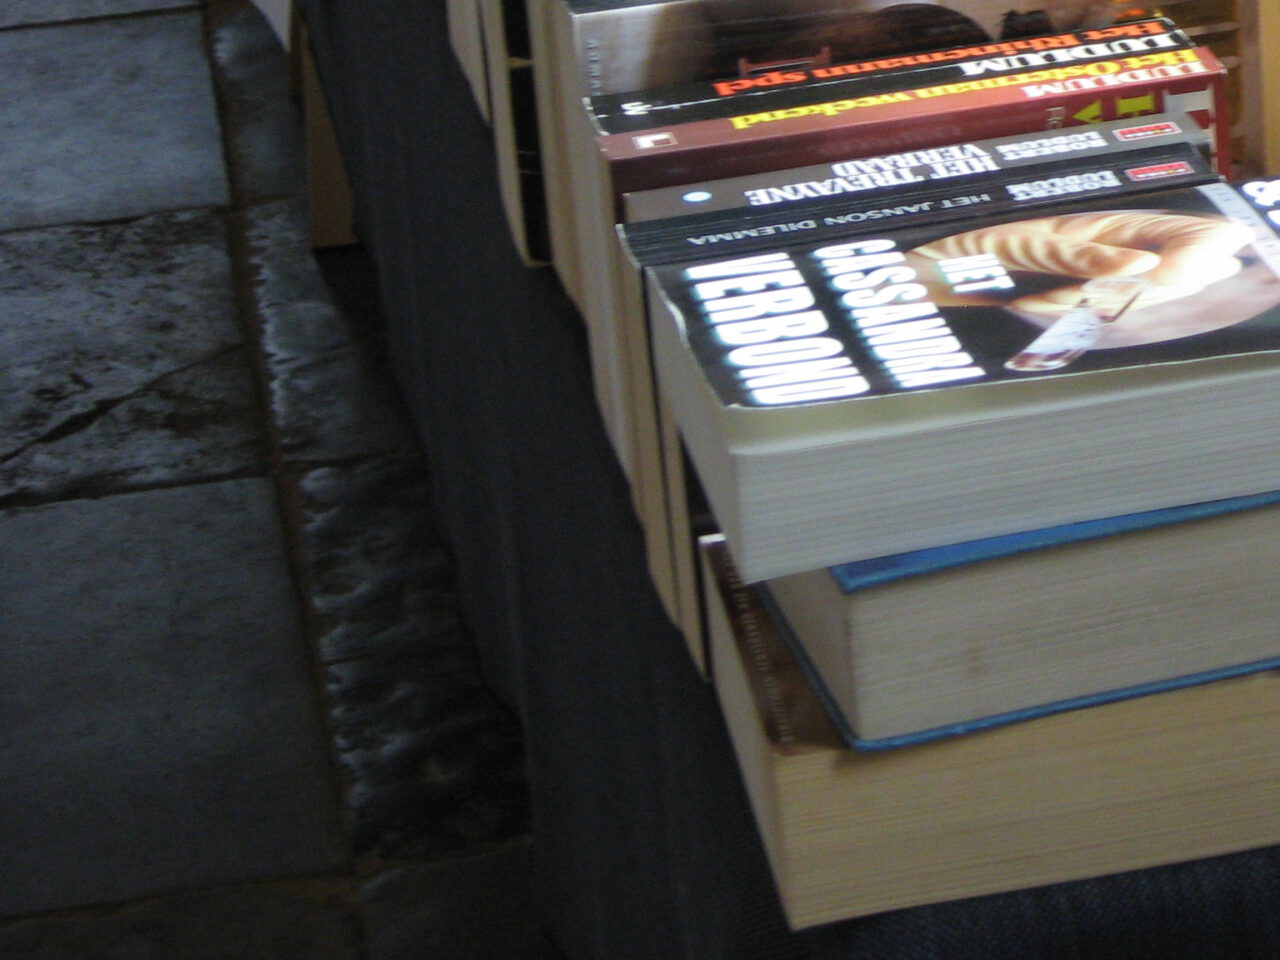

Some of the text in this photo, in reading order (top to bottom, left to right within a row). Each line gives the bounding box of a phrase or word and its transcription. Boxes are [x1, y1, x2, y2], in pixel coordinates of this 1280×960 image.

[710, 20, 1167, 97] Het Rhinemann spel
[959, 32, 1180, 76] LUDLUM
[729, 48, 1199, 129] Het Osterman weekend
[1021, 61, 1209, 98] LUDLUM
[830, 143, 992, 180] VERRAAD
[994, 130, 1101, 156] LUDLUM
[1001, 136, 1109, 162] ROBERT
[744, 154, 1001, 206] HET TREVAYNE
[1005, 170, 1116, 197] LUDLUM
[1010, 176, 1122, 202] ROBERT
[685, 192, 993, 247] HET JANSON DILEMMA
[935, 252, 1016, 294] HET
[684, 251, 871, 406] VERBOND
[809, 238, 987, 389] CASSANDRA
